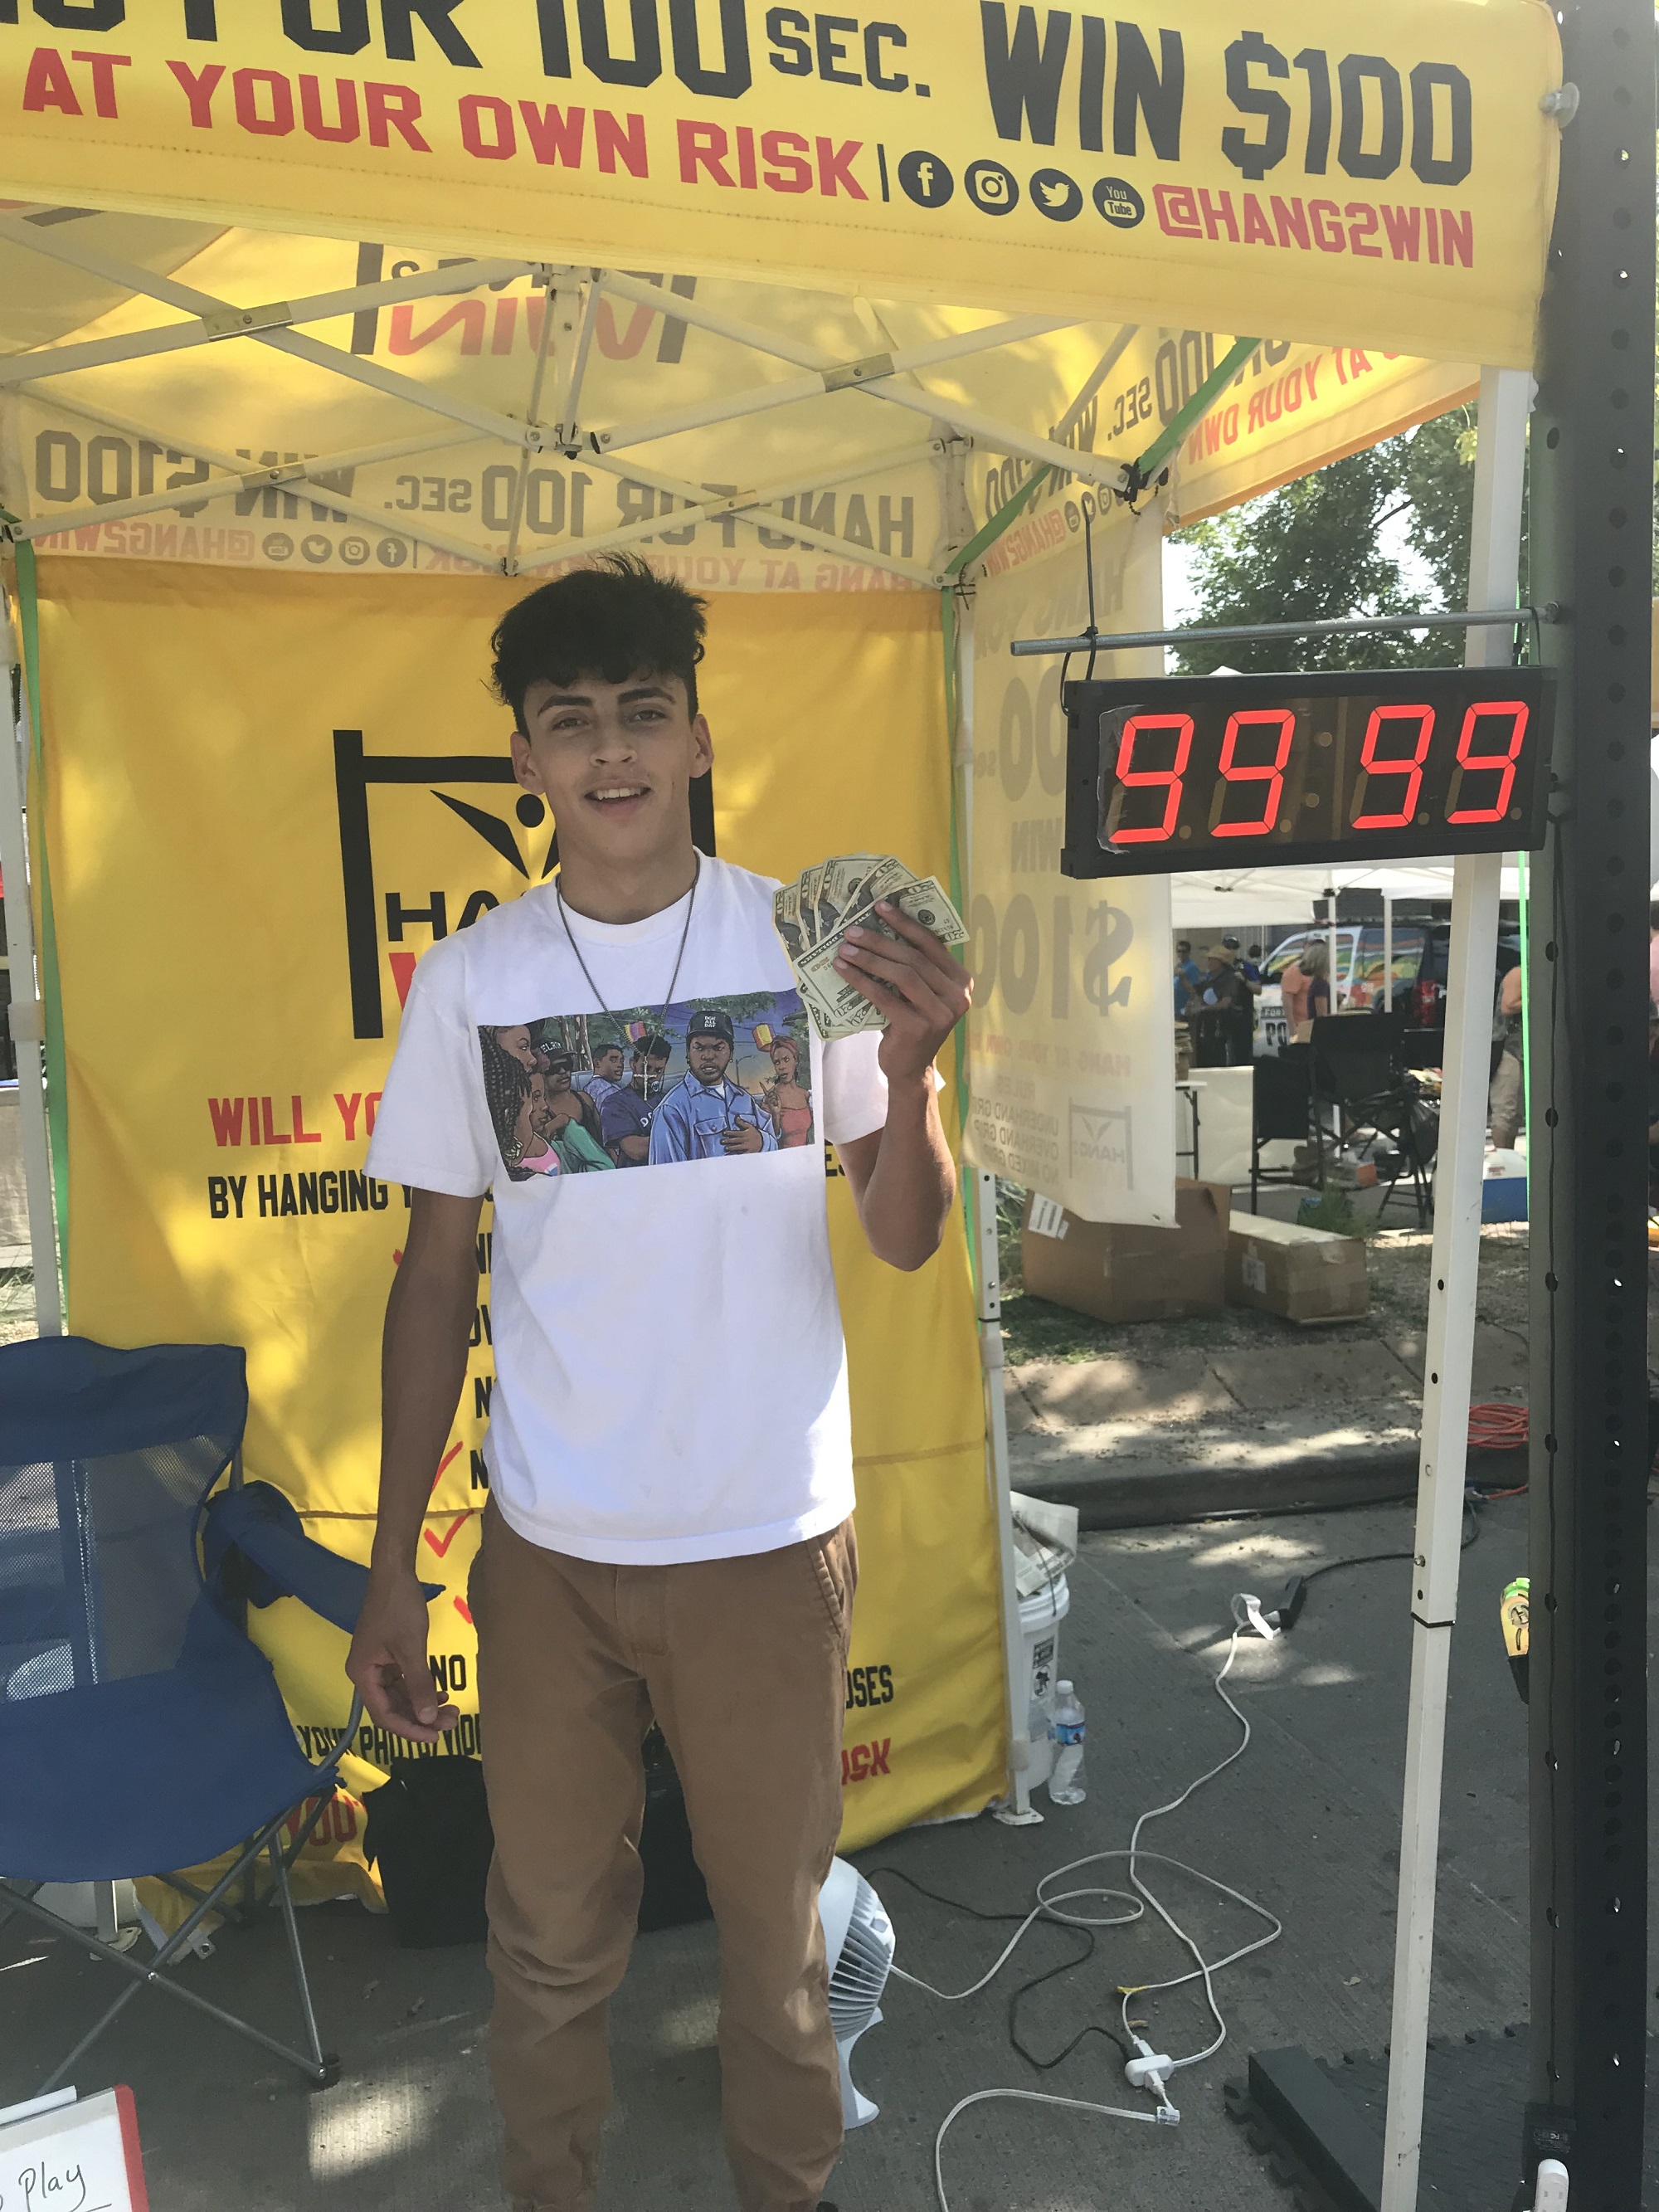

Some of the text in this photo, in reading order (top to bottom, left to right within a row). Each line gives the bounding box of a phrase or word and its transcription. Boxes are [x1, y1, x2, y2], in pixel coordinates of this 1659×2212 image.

[766, 7, 931, 97] SEC.
[980, 0, 1185, 161] WIN
[1222, 31, 1472, 186] $100
[22, 47, 132, 119] AT
[165, 60, 432, 153] YOUR
[458, 94, 649, 178] OWN
[677, 119, 869, 201] RISK
[1153, 183, 1474, 268] @HANG2WIN
[208, 1095, 322, 1147] WILL
[208, 1175, 247, 1219] BY
[257, 1169, 389, 1218] HANGING
[429, 1654, 467, 1691] NO
